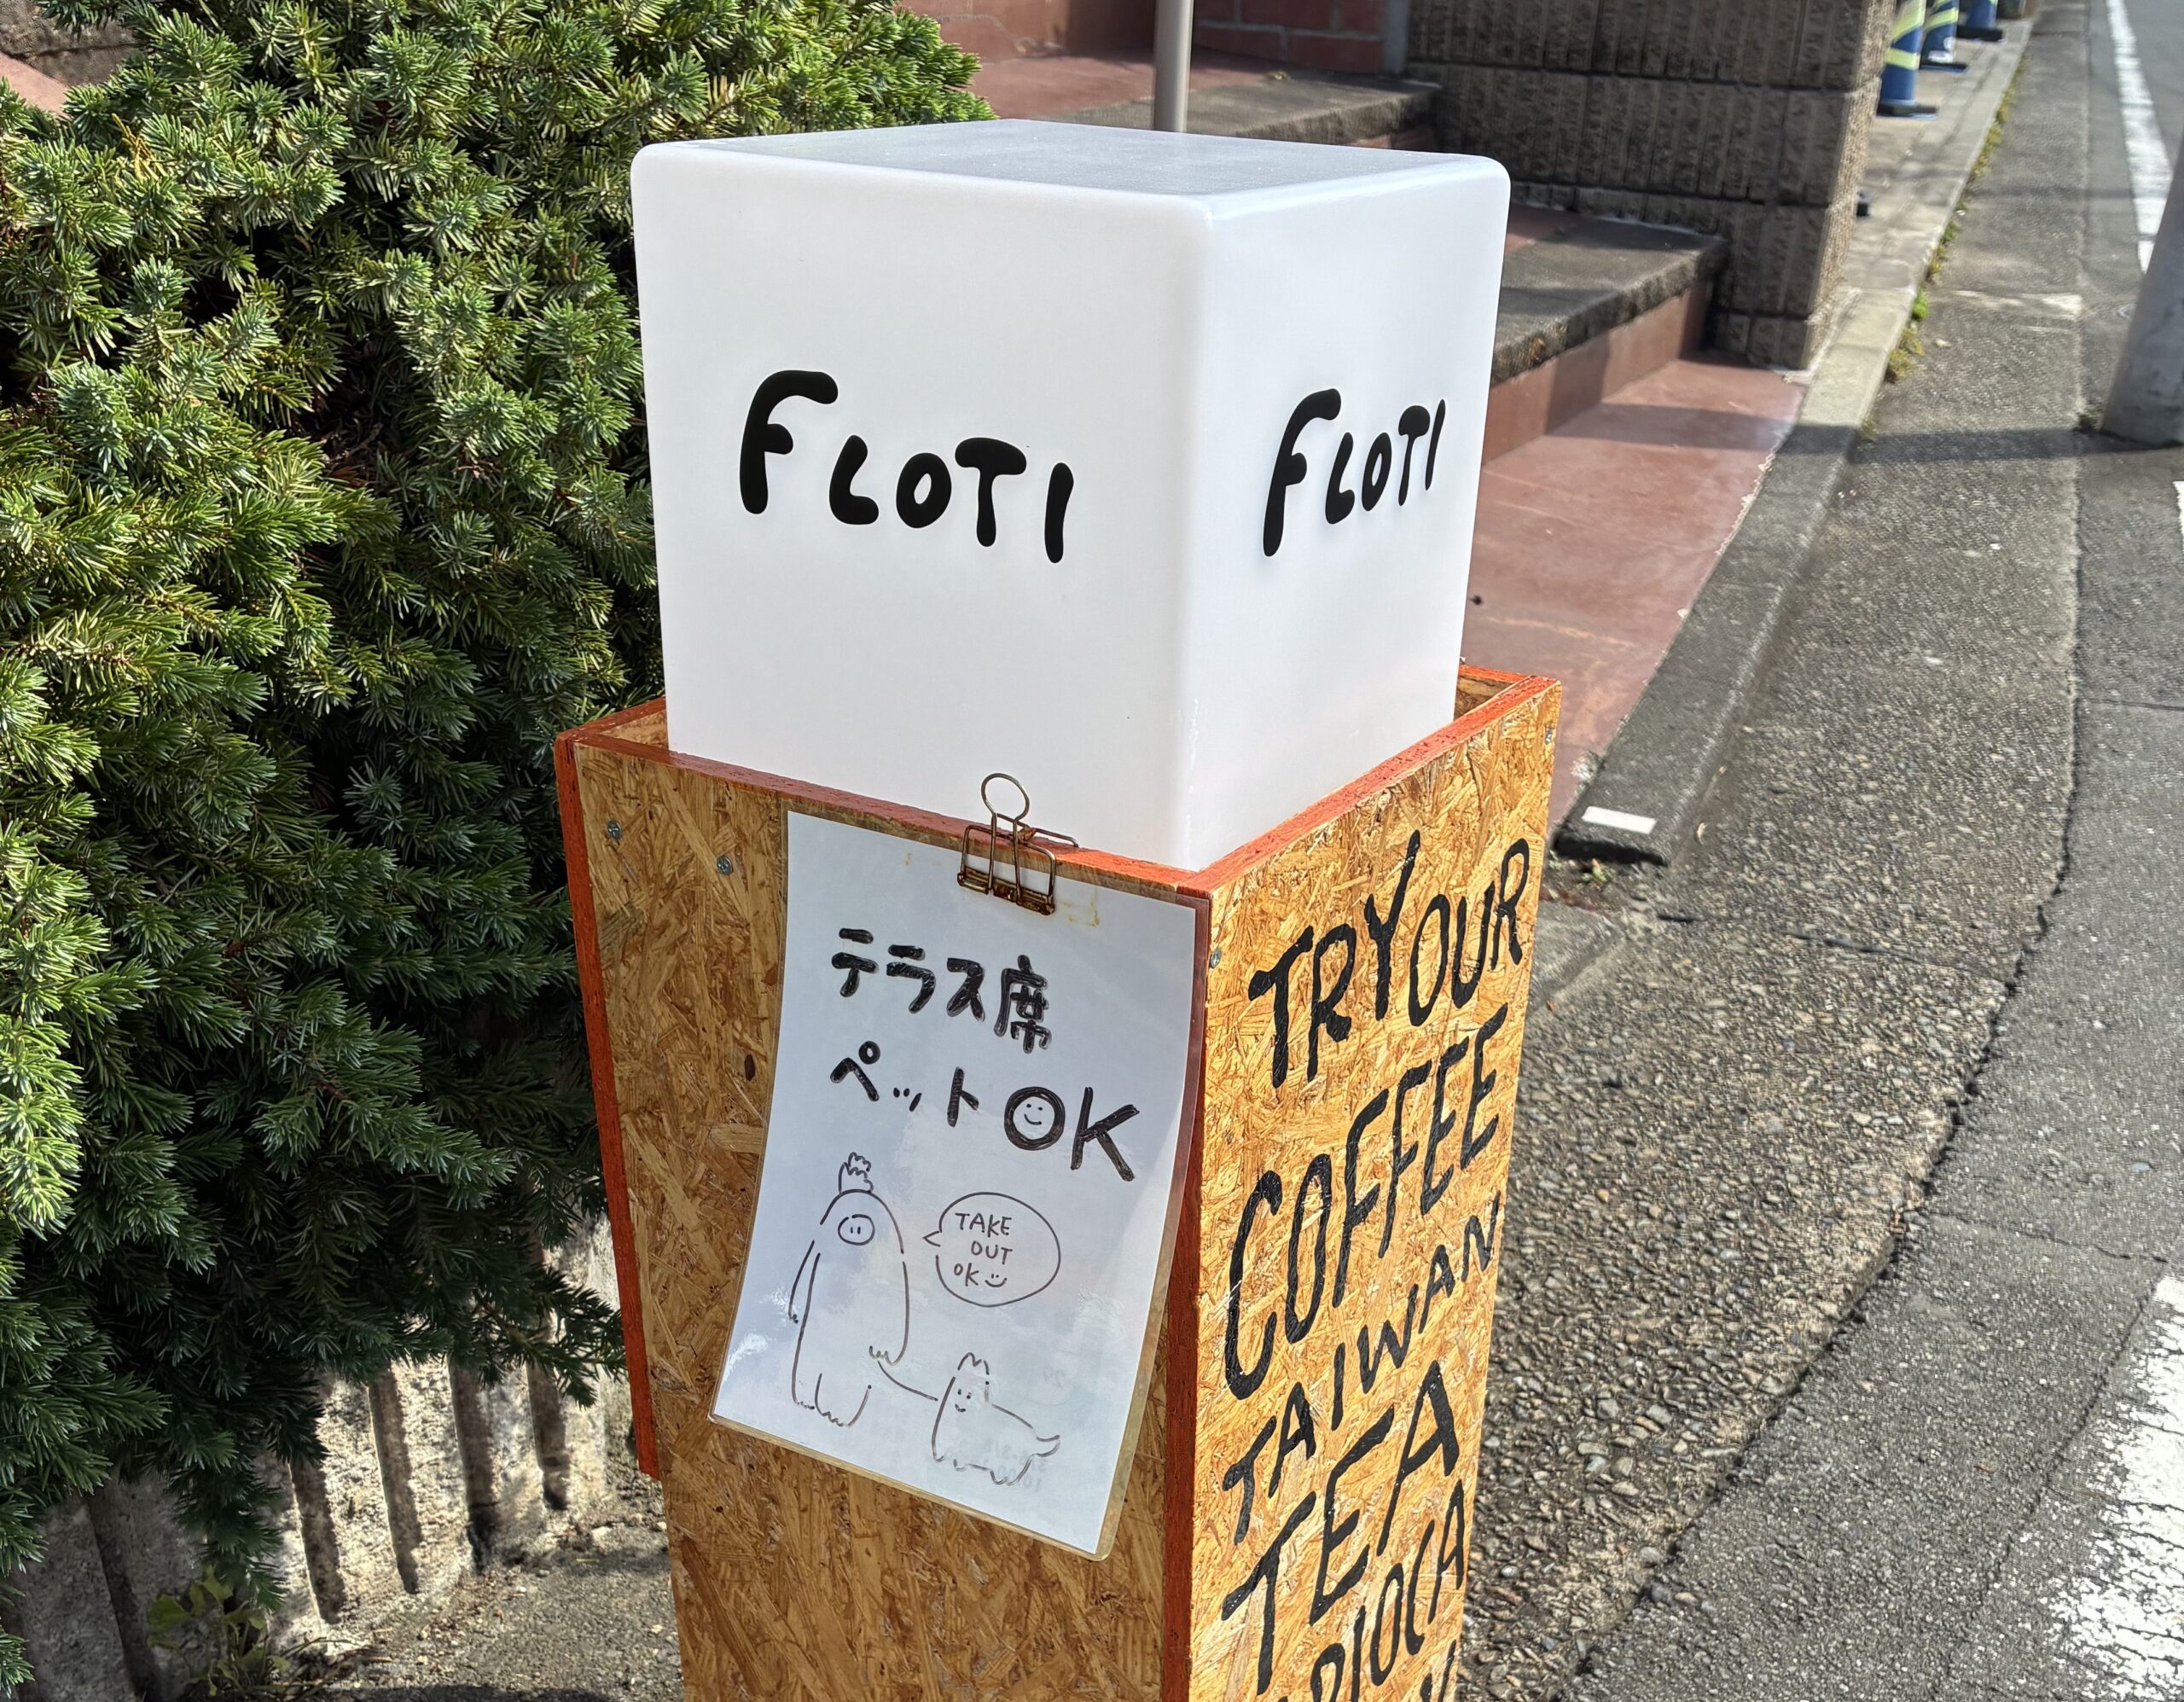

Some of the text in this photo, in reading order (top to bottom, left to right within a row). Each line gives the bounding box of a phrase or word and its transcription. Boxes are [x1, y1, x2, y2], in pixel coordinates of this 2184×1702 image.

[740, 369, 1074, 564] FLOTI
[1263, 387, 1447, 557] FLOTI
[830, 927, 1053, 1054] テラス席
[953, 1262, 979, 1287] OK
[955, 1212, 1013, 1238] TAKE
[971, 1240, 1014, 1265] OUT
[1224, 1002, 1508, 1401] COFFEE
[1222, 1190, 1502, 1546] TAIWAN
[1221, 1360, 1460, 1695] TEA
